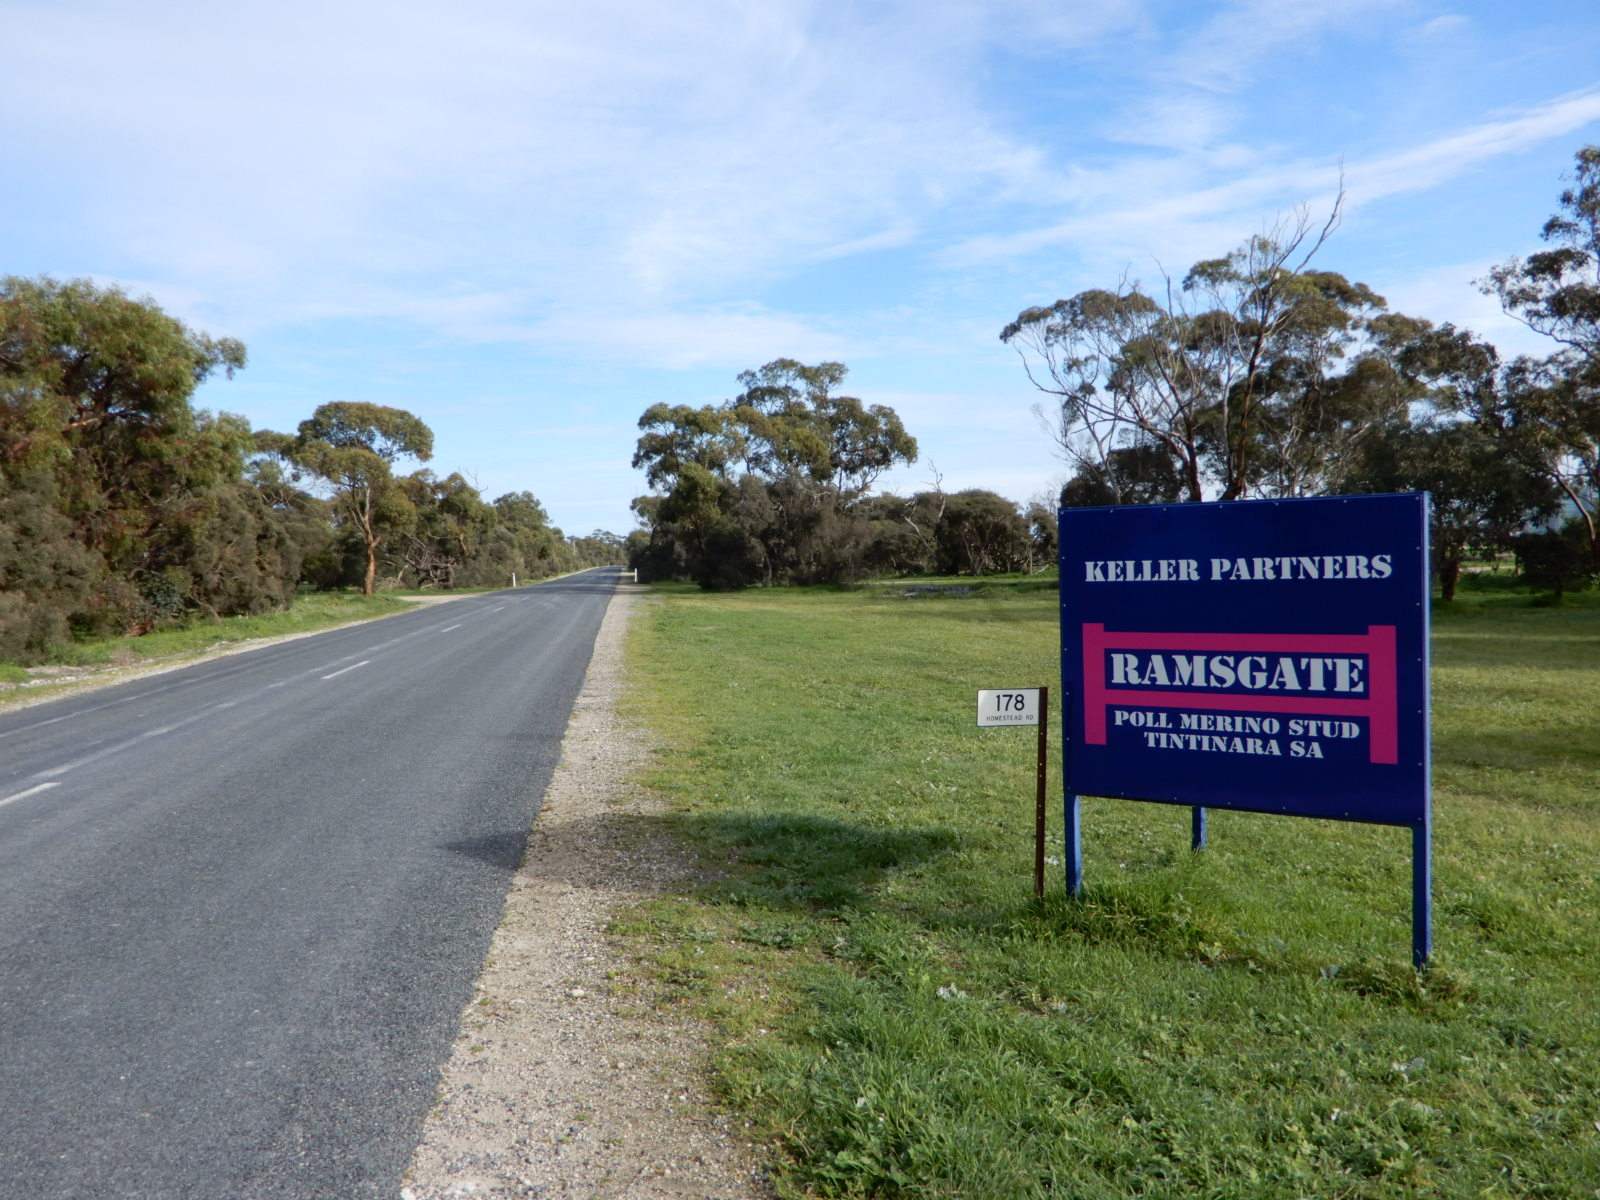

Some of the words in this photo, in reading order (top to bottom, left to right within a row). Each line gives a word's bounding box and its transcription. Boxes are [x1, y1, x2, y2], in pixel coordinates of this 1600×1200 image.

[1084, 559, 1200, 582] KELLER
[1210, 554, 1393, 581] PARTNERS
[1111, 653, 1364, 693] RAMSGATE
[996, 694, 1025, 712] 178
[1114, 710, 1172, 730] POLL
[1180, 713, 1280, 735] MERINO
[1288, 719, 1360, 739] STUD
[1144, 731, 1281, 756] TINTINARA
[1290, 741, 1324, 759] SA
